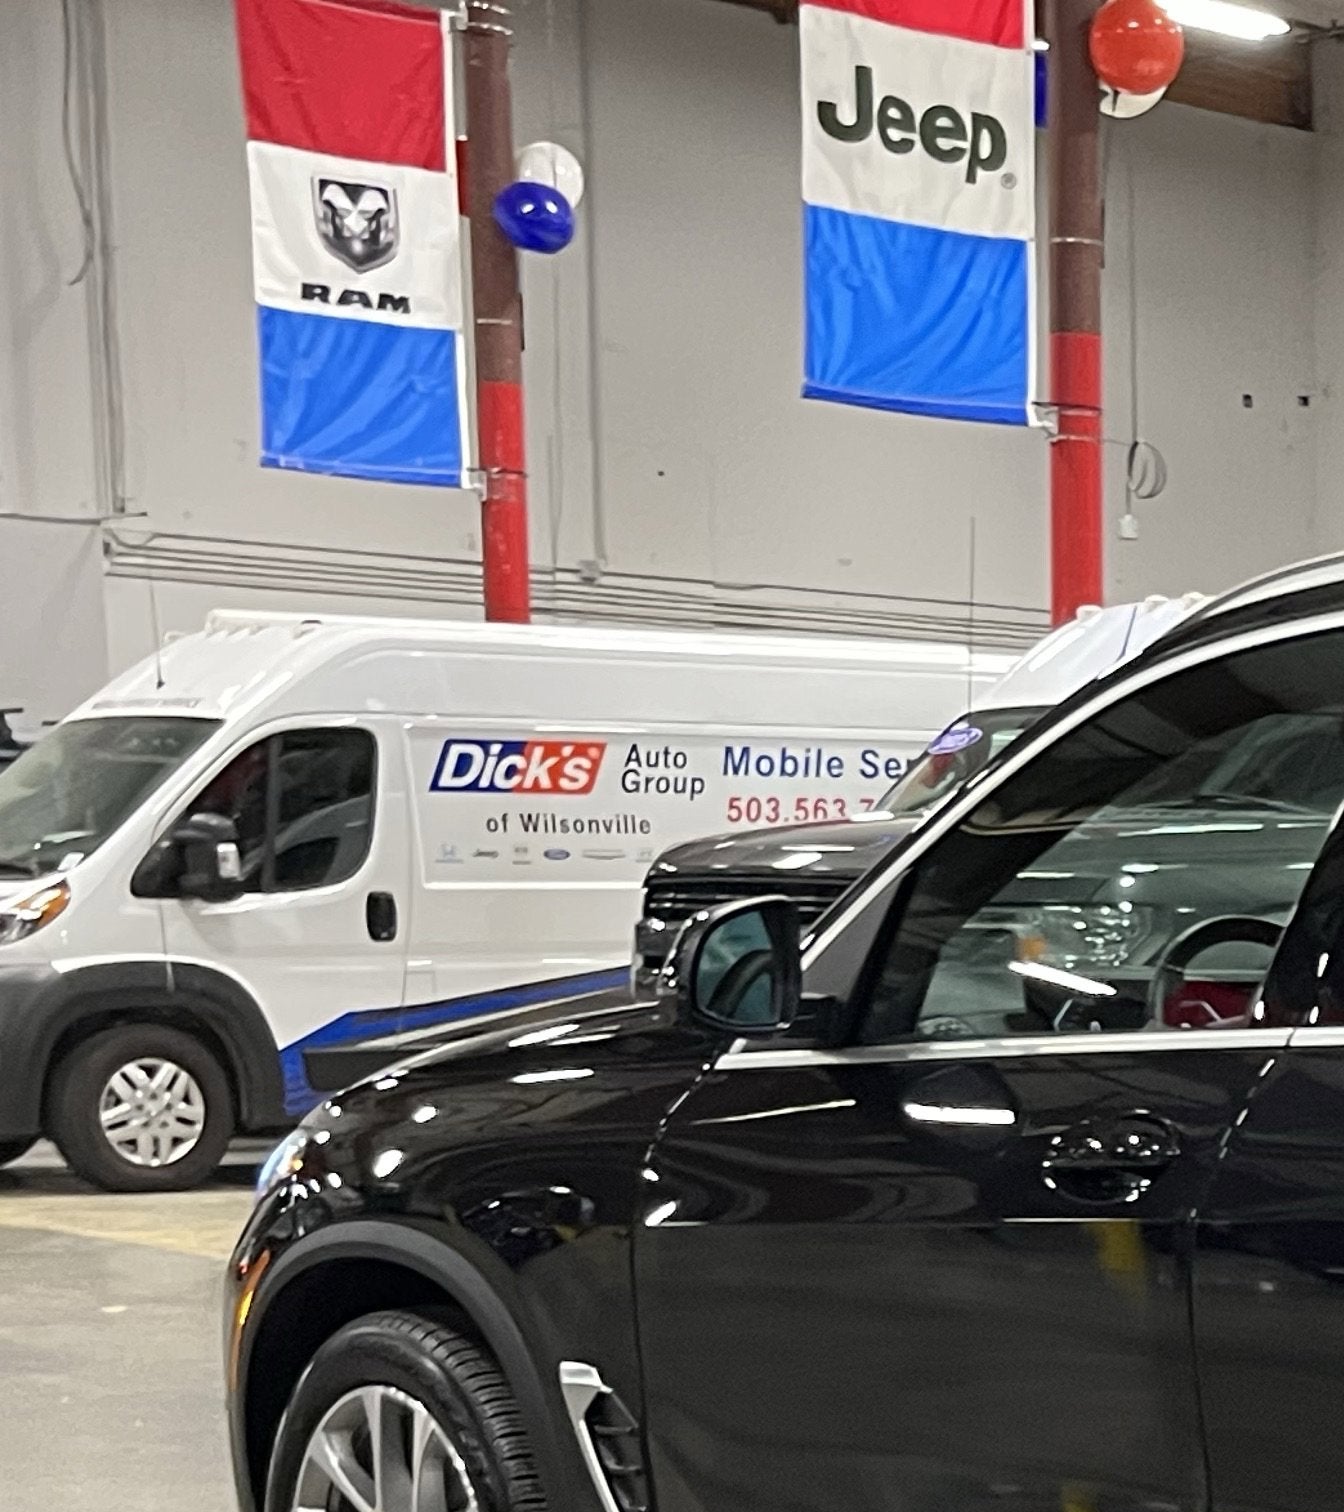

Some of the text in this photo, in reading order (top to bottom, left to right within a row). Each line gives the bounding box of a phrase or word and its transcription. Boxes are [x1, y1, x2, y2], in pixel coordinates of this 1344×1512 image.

[817, 65, 1007, 185] Jeep
[300, 282, 412, 315] RAM
[437, 742, 594, 791] Dick's
[624, 743, 688, 769] Auto
[722, 745, 845, 779] Mobile
[620, 769, 706, 801] Group
[486, 812, 652, 835] of Wilsonville
